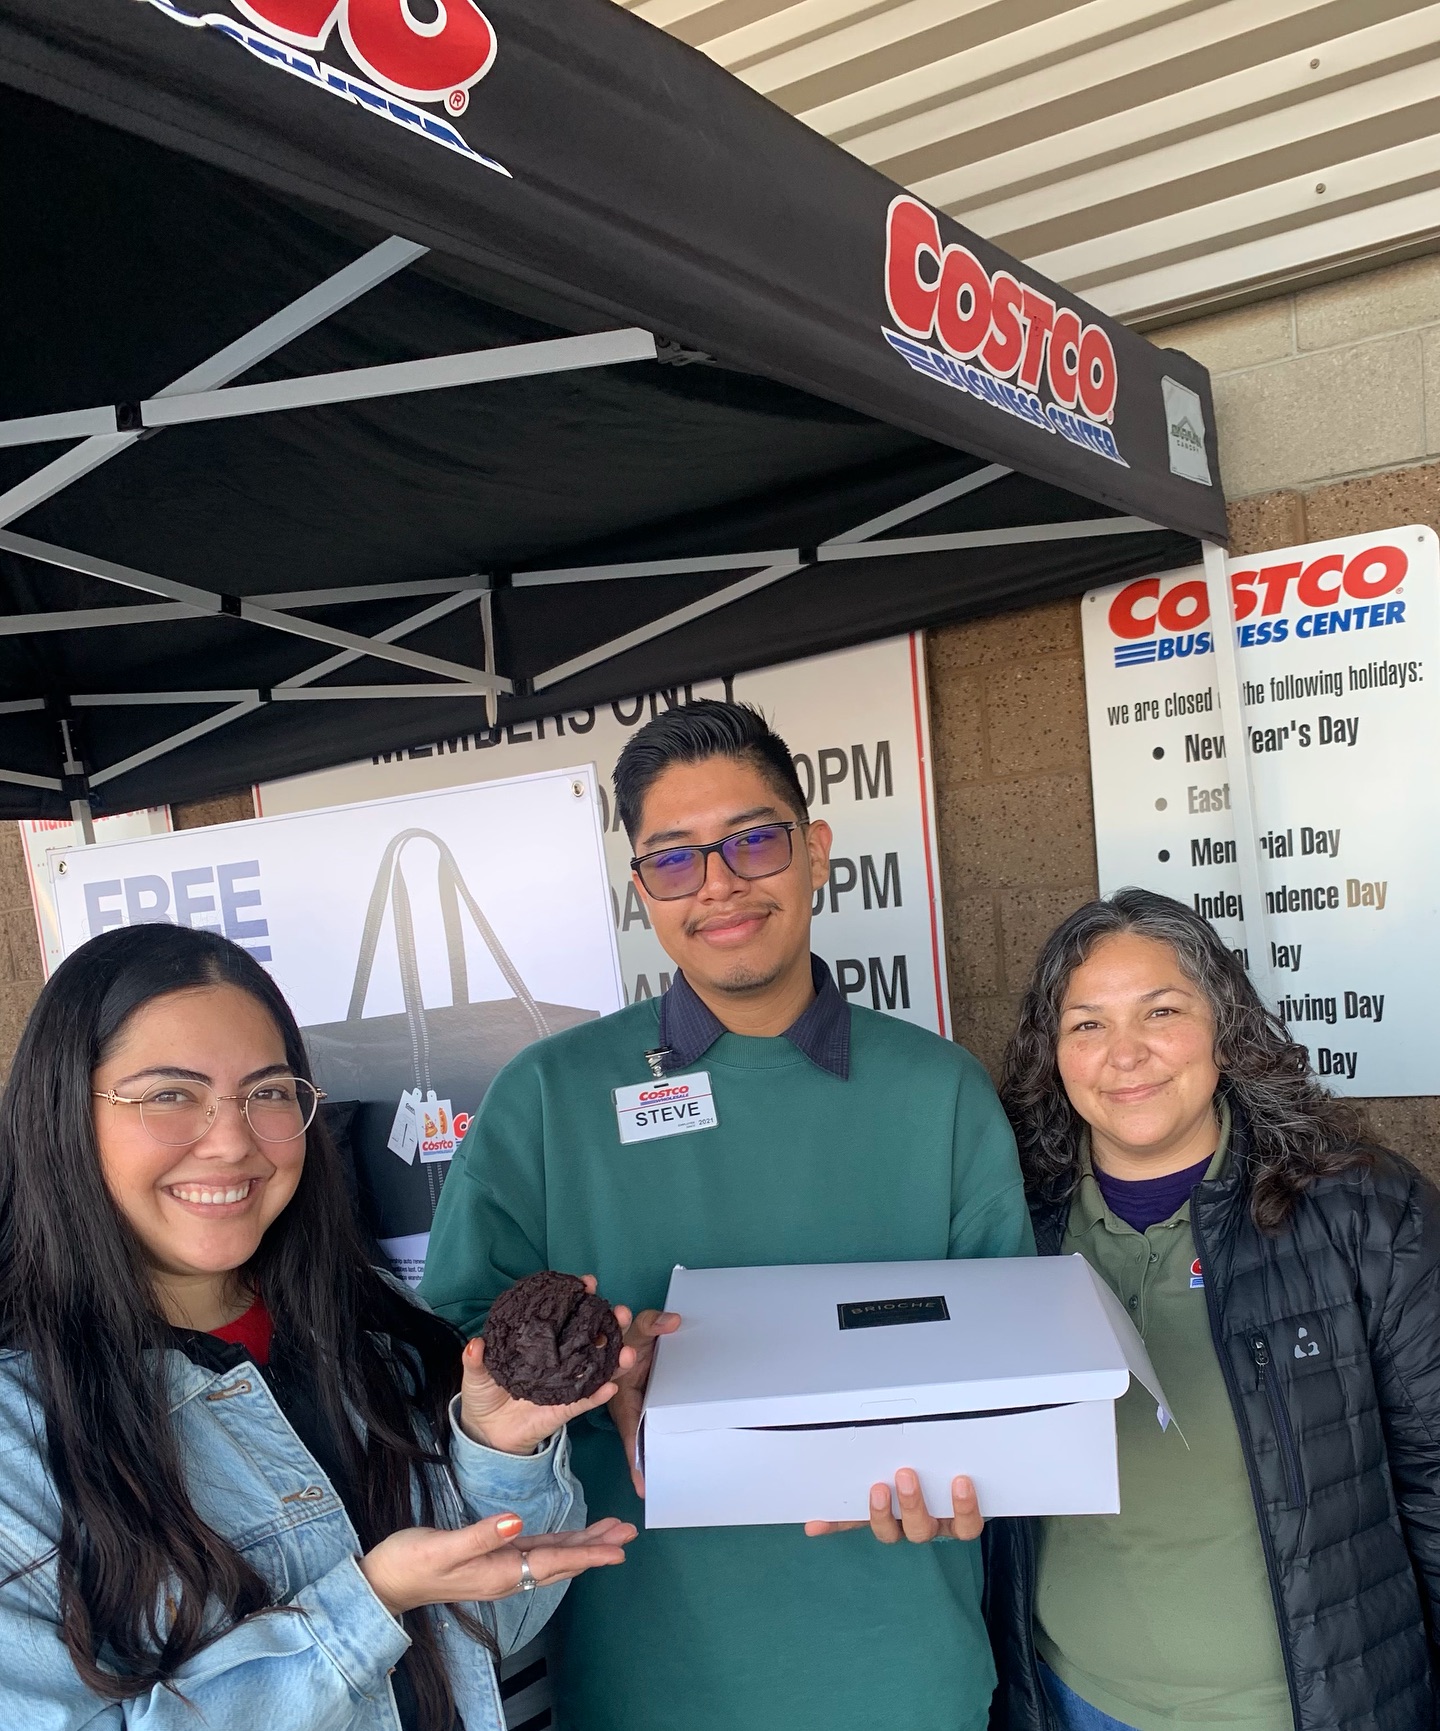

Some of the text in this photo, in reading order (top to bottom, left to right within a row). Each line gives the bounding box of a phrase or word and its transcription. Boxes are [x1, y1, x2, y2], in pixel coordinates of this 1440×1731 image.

[885, 194, 1117, 420] COSTCO
[931, 351, 1120, 459] BUSINESS CENTER
[1108, 545, 1408, 640] COSTCO
[1157, 600, 1406, 661] BUSESS CENTER
[1108, 704, 1129, 726] we
[1134, 699, 1159, 721] are
[1165, 687, 1213, 718] closed
[1270, 670, 1343, 702] following
[1348, 660, 1423, 691] holidays:
[1248, 720, 1311, 754] ear's
[1318, 715, 1360, 747] Day
[1187, 783, 1231, 815] East
[1300, 826, 1341, 858] Day
[83, 860, 270, 938] FREE
[1345, 878, 1388, 911] Day
[1344, 991, 1385, 1023] Day
[1317, 1048, 1358, 1079] Day
[639, 1085, 689, 1101] COSTCO
[636, 1102, 700, 1126] STEVE
[698, 1117, 714, 1126] 2021
[422, 1140, 454, 1151] COSTCO
[851, 1302, 936, 1315] BRIOCHE
